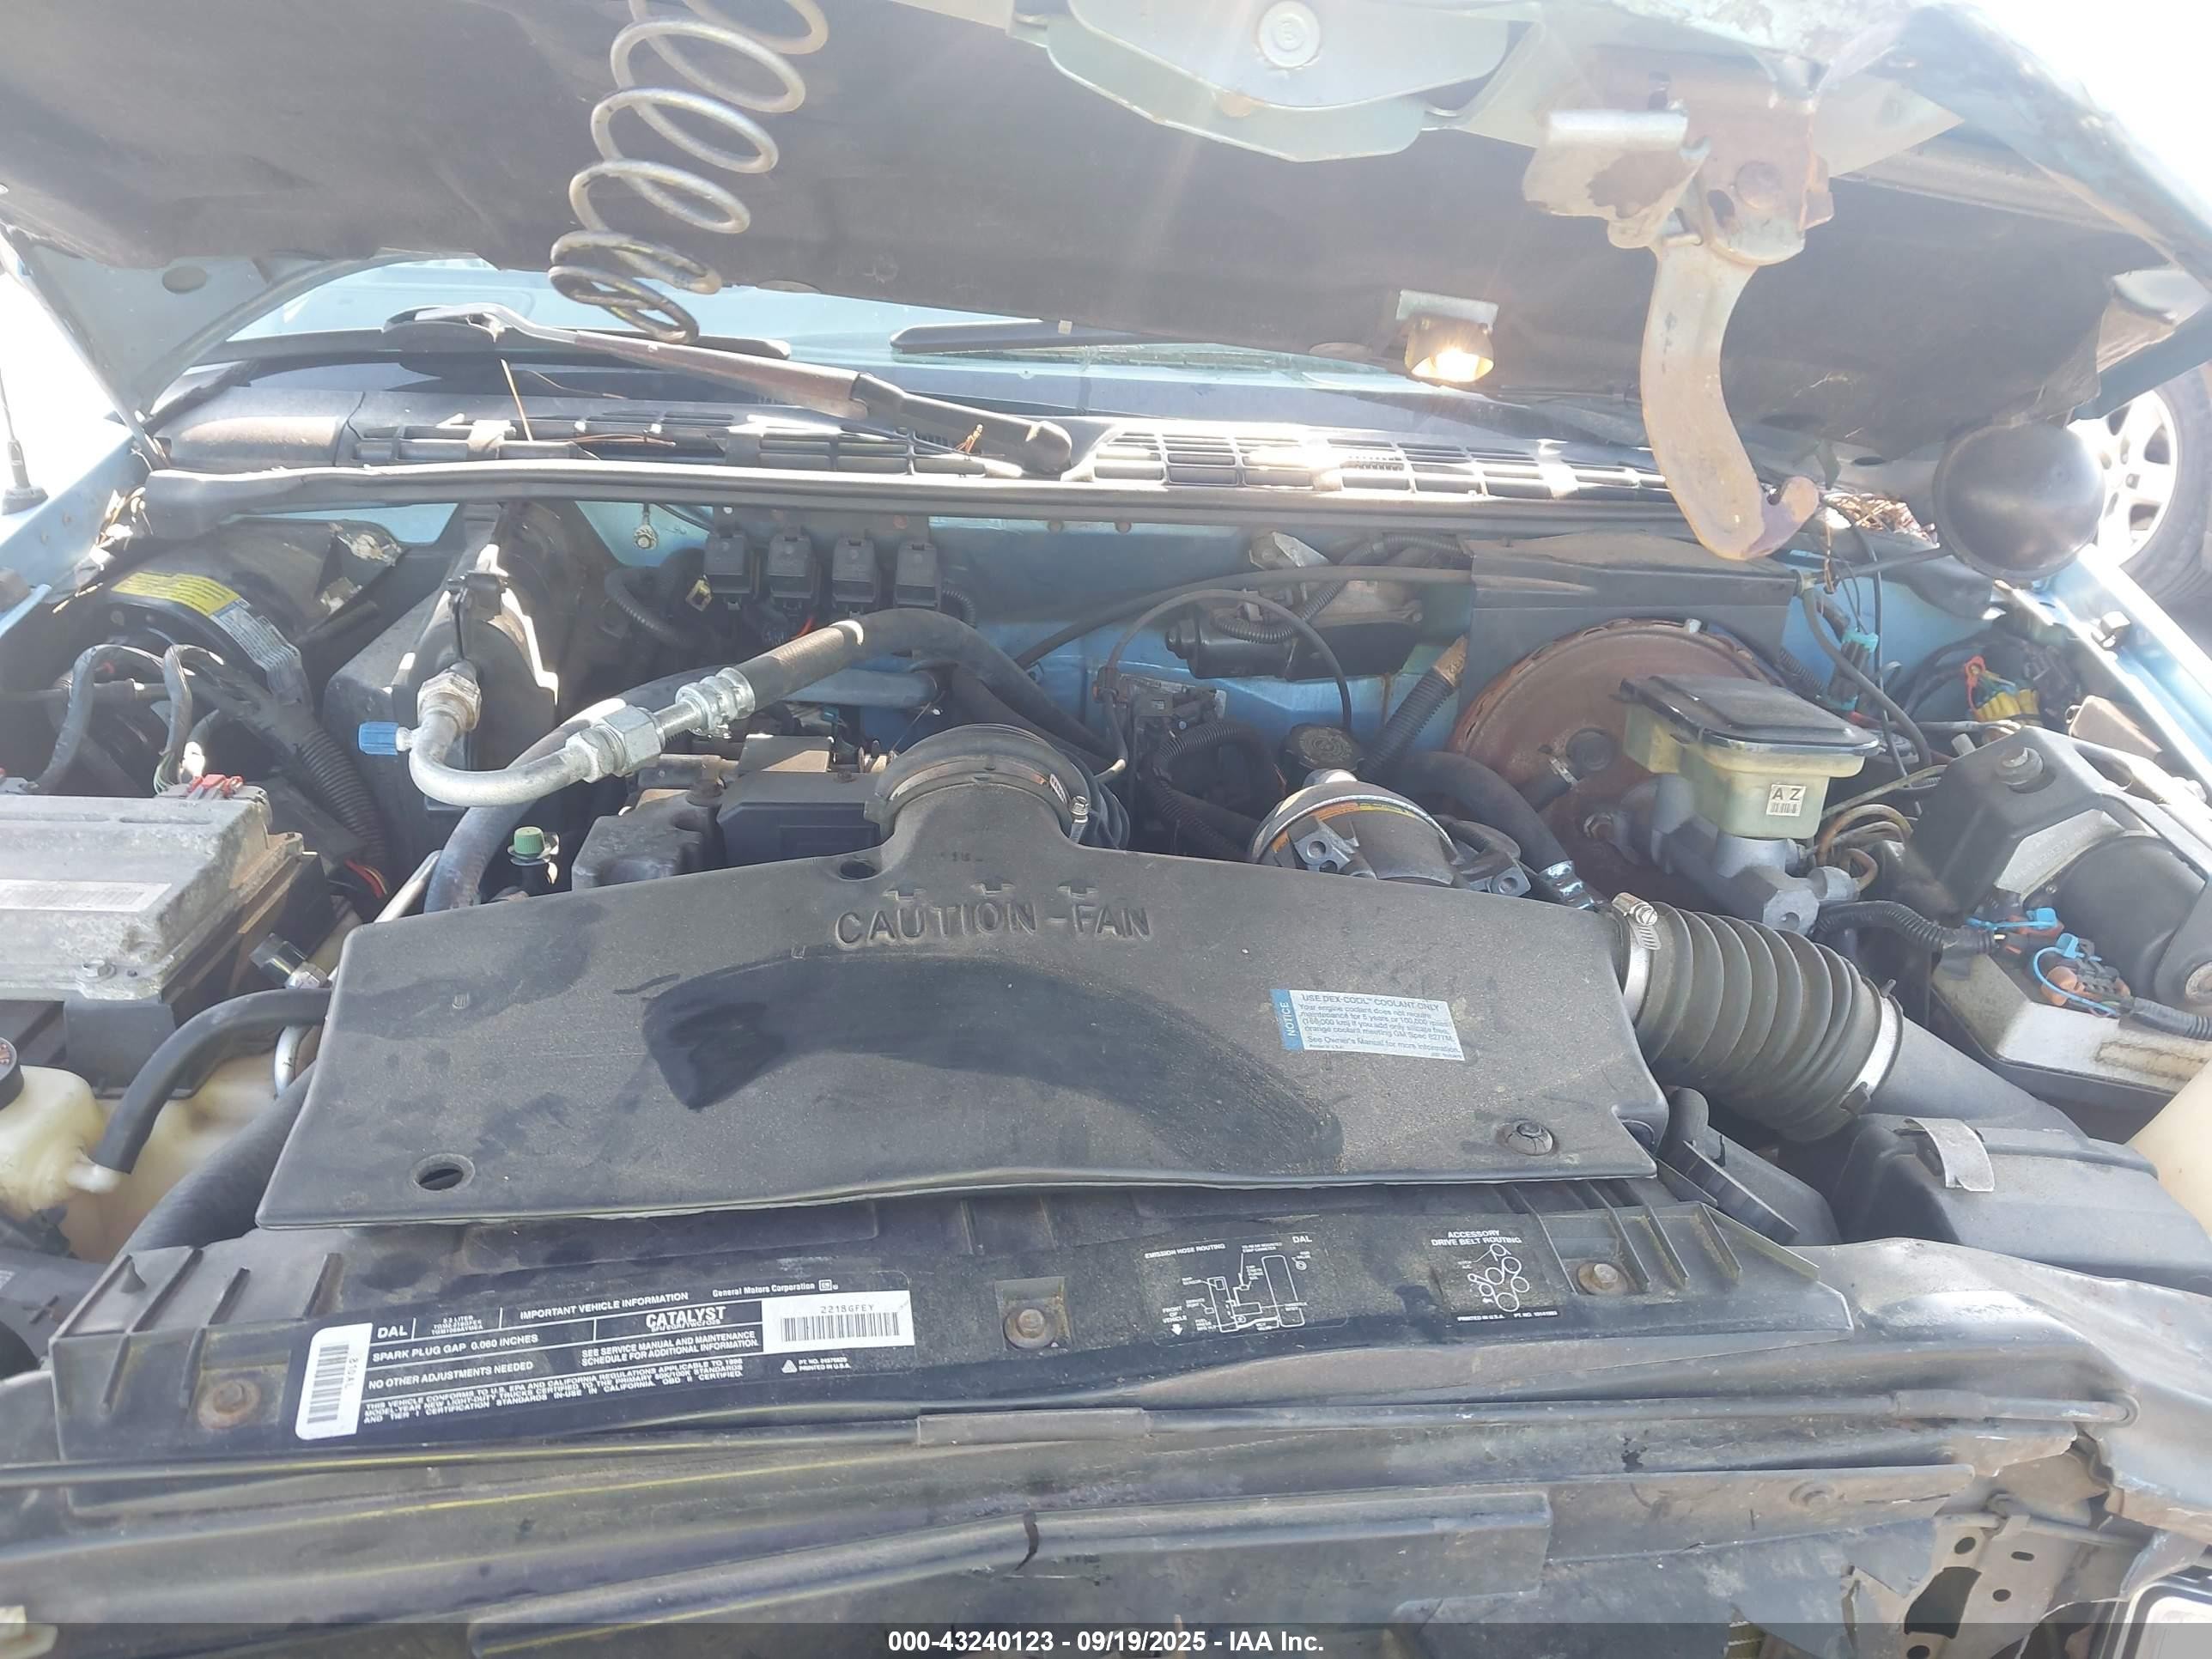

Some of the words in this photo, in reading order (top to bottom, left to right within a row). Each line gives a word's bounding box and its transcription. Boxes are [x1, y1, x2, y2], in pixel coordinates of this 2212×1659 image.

[834, 899, 1040, 950] CAUTION
[1302, 994, 1322, 1003] USE
[1374, 998, 1416, 1009] COOLANT
[1418, 1002, 1440, 1012] ONLY
[1279, 1001, 1297, 1037] NOTICE
[1300, 1011, 1349, 1020] maintenance
[1409, 1032, 1427, 1040] Spec
[1292, 1235, 1313, 1244] DAL
[1447, 1229, 1500, 1238] ACCESSORY
[1196, 1243, 1226, 1252] ROUTING
[712, 1288, 742, 1298] General
[744, 1285, 770, 1295] Motors
[771, 1282, 815, 1292] Corporation
[520, 1306, 577, 1320] IMPORTANT
[579, 1300, 620, 1313] VEHICLE
[622, 1292, 689, 1307] INFORMATION
[820, 1304, 875, 1314] 2218GFEY
[646, 1306, 726, 1328] CATALYST
[1162, 1315, 1187, 1323] VEHICLE
[377, 1325, 408, 1340] DAL
[372, 1349, 409, 1363] SPARK
[412, 1345, 441, 1357] PLUG
[443, 1343, 466, 1354] GAP
[471, 1340, 497, 1351] 0.060
[500, 1334, 539, 1347] INCHES
[582, 1348, 599, 1358] SEE
[601, 1343, 637, 1355] SERVICE
[639, 1340, 674, 1352] MANUAL
[676, 1337, 693, 1347] AND
[695, 1331, 755, 1344] MAINTENANCE
[581, 1353, 627, 1367] SCHEDULE
[629, 1352, 647, 1361] FOR
[649, 1346, 699, 1359] ADDITIONAL
[369, 1379, 384, 1390] NO
[386, 1375, 419, 1388] OTHER
[421, 1367, 492, 1383] ADJUSTMENTS
[494, 1361, 534, 1374] NEEDED
[388, 1397, 424, 1407] VEHICLE
[426, 1392, 474, 1402] CONFORMS
[528, 1382, 546, 1390] AND
[547, 1376, 598, 1388] CALIFORNIA
[599, 1369, 656, 1381] REGULATIONS
[658, 1361, 709, 1373] APPLICABLE
[424, 1400, 444, 1409] NEW
[499, 1390, 533, 1399] TRUCKS
[535, 1384, 579, 1395] CERTIFIED
[615, 1374, 653, 1385] PRIMARY
[694, 1364, 743, 1376] STANDARDS
[363, 1415, 383, 1424] AND
[425, 1402, 490, 1416] CERTIFICATION
[496, 1394, 548, 1407] STANDARDS
[554, 1390, 582, 1400] IN-USE
[662, 1377, 680, 1385] OBD
